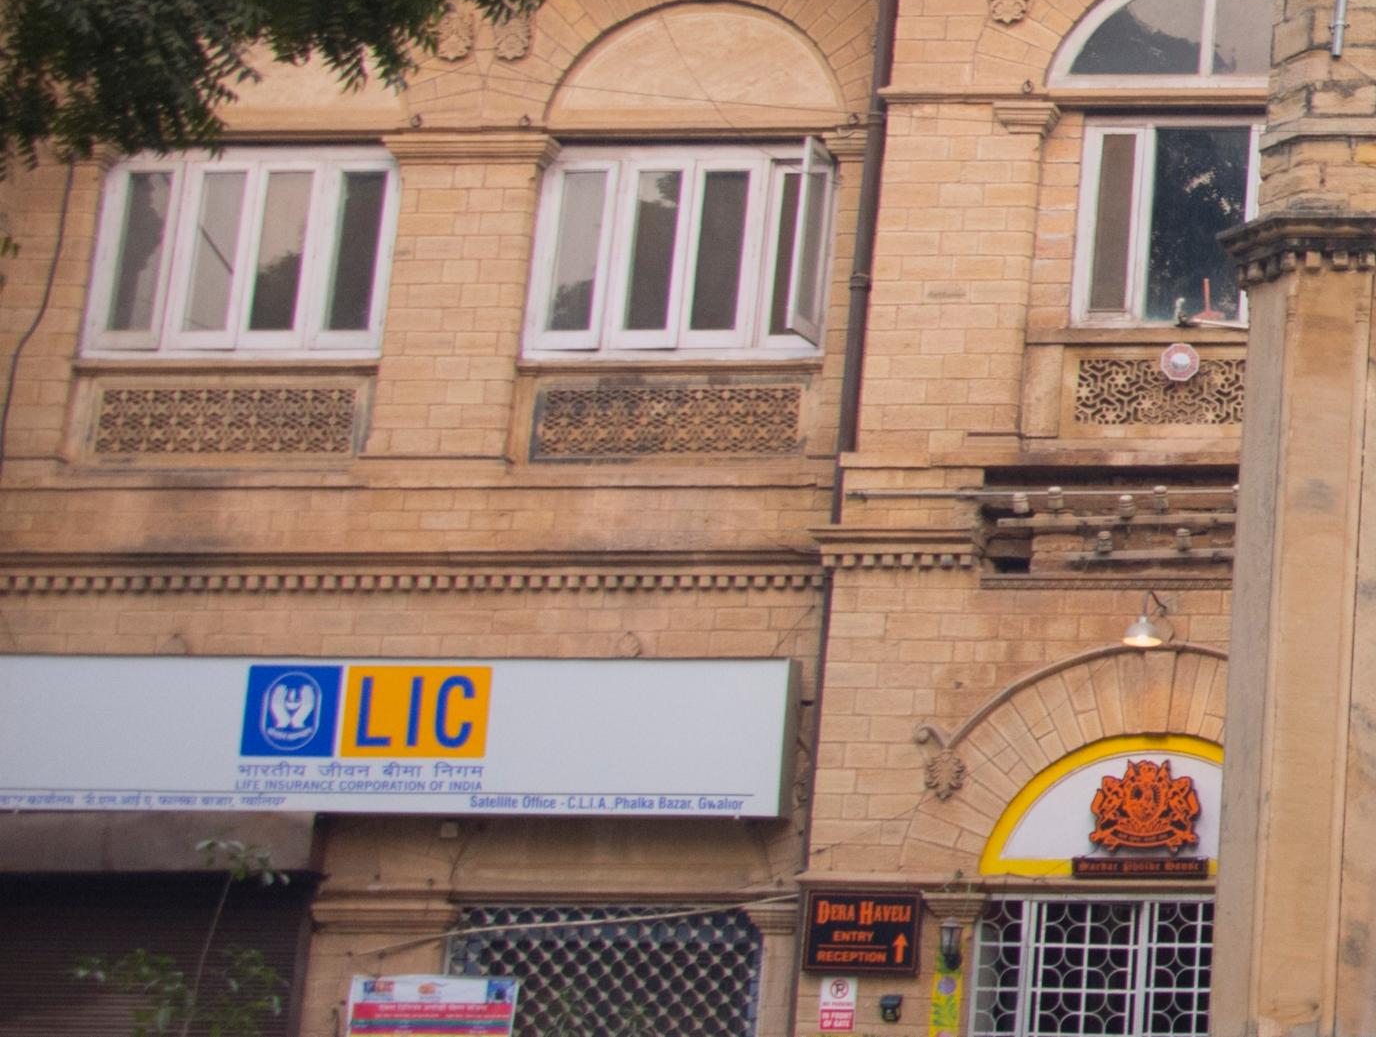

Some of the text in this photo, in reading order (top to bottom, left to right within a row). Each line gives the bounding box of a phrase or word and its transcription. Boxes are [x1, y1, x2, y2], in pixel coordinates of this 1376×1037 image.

[355, 675, 476, 749] LIC
[238, 761, 485, 778] भारतीय जीवन बीमा निगम
[235, 780, 483, 792] LIFE INSURANCE CORPORATION OF INDIA
[469, 795, 519, 810] Satellite
[522, 795, 557, 810] Office
[698, 797, 745, 811] Gwalior
[816, 900, 912, 925] DERA HAVELI
[832, 930, 875, 942] ENTRY
[816, 950, 887, 963] RECEPTION
